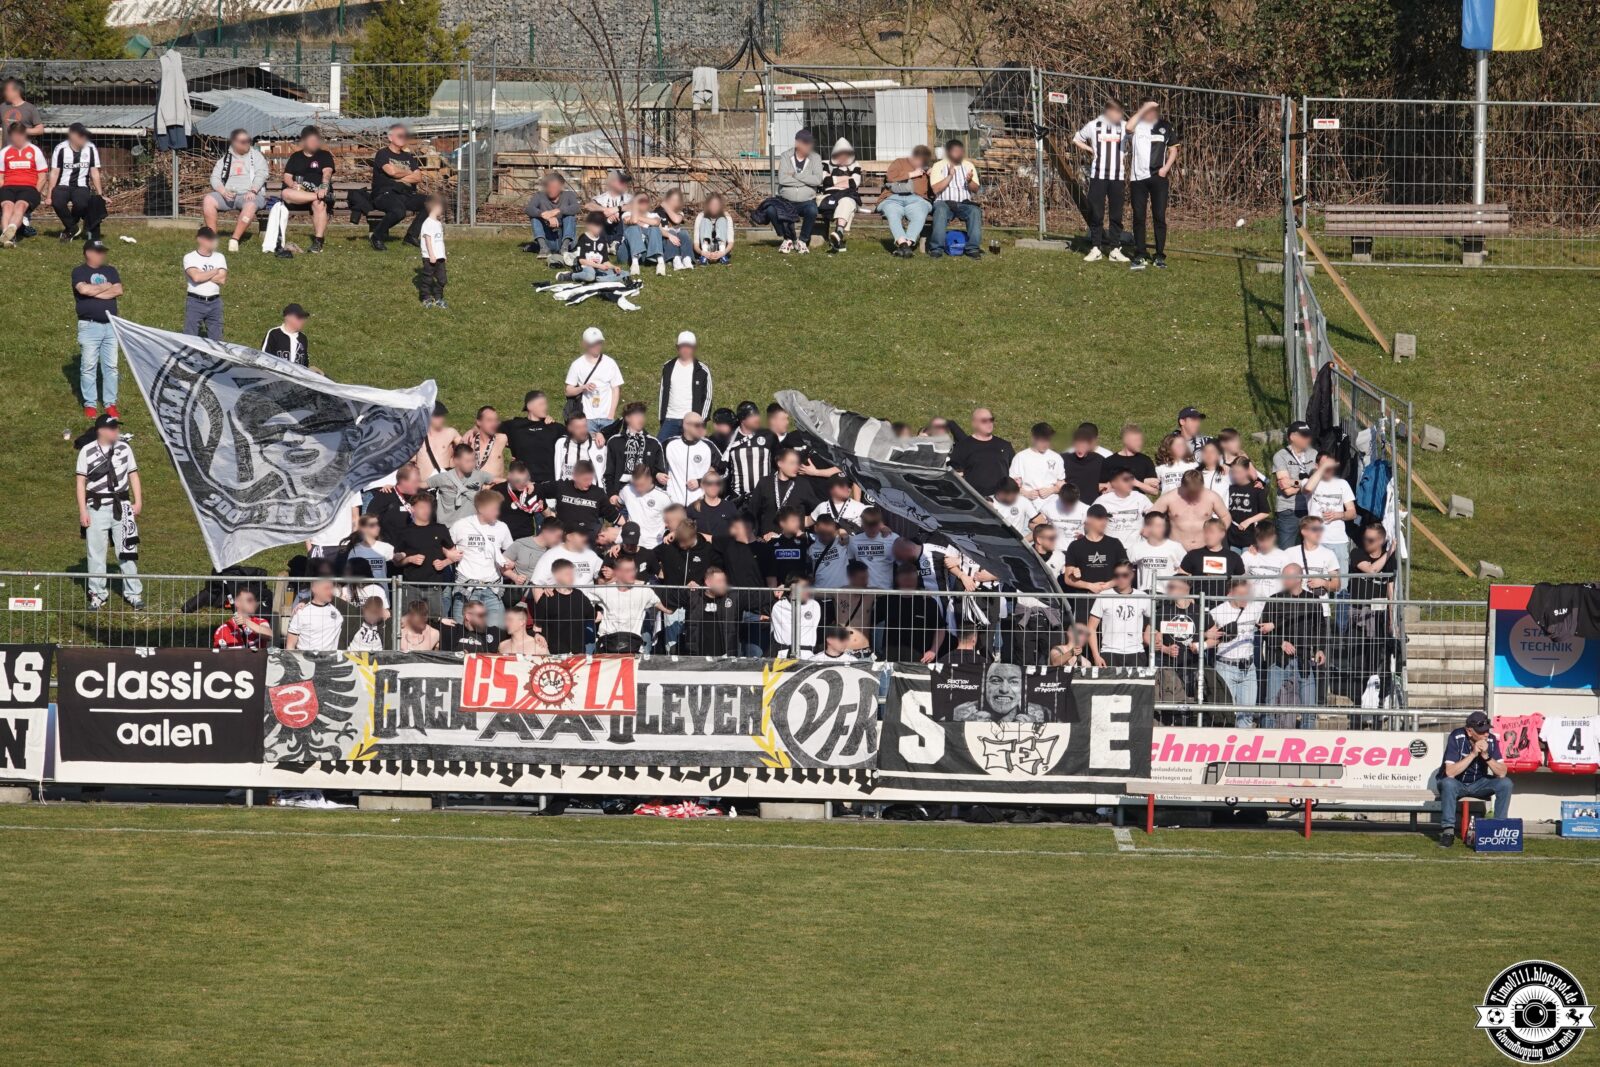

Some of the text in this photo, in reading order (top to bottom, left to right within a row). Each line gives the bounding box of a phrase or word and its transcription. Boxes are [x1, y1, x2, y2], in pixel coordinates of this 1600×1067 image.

[1519, 641, 1573, 653] TECHNIK
[75, 661, 255, 700] classics
[584, 657, 636, 711] LA
[117, 718, 213, 747] aalen
[1567, 727, 1584, 755] 4
[1151, 734, 1412, 767] chmid-Reisen
[1478, 837, 1518, 845] SPORTS
[1494, 827, 1520, 838] ultra
